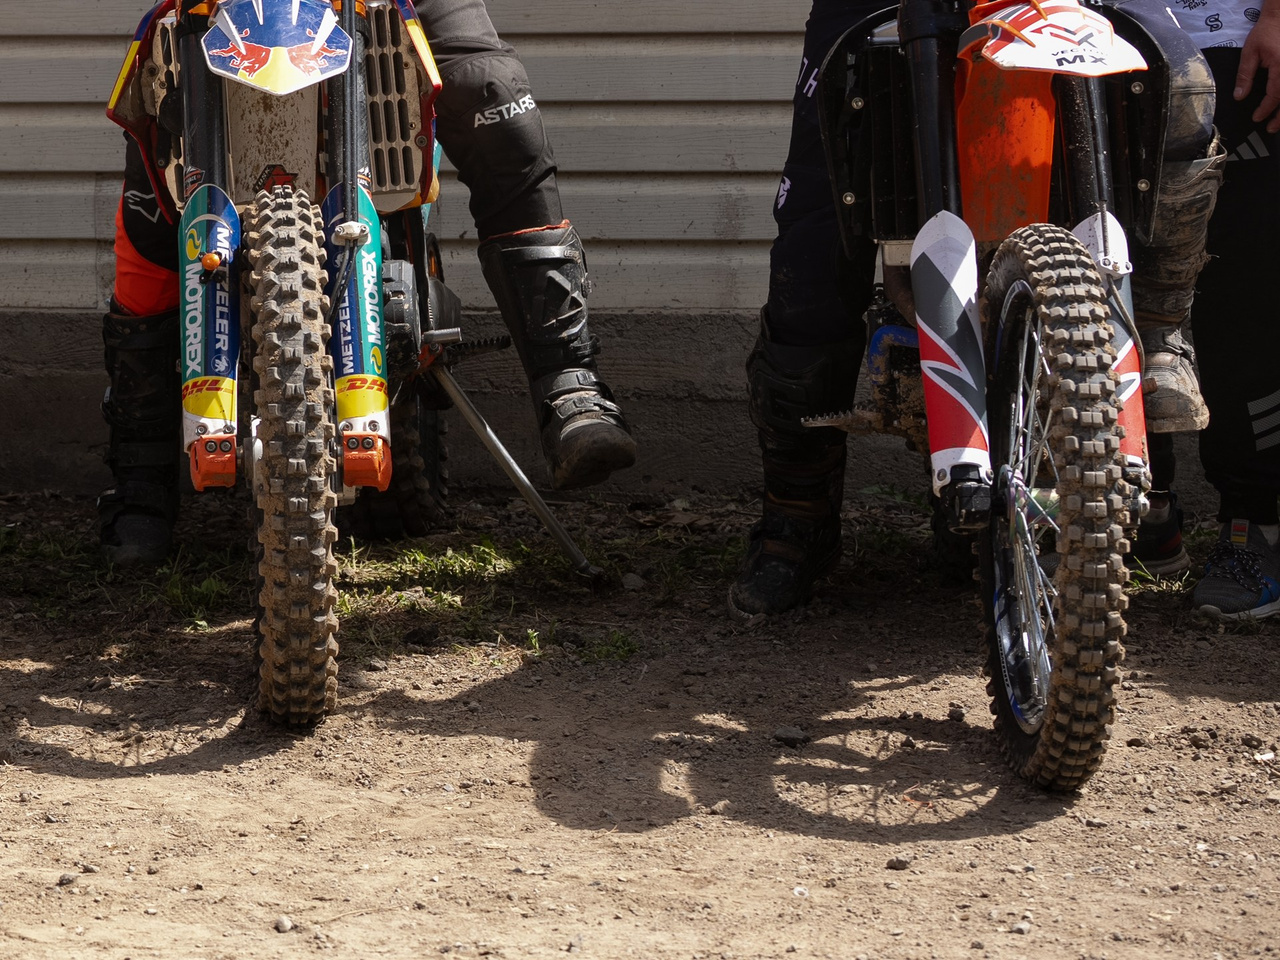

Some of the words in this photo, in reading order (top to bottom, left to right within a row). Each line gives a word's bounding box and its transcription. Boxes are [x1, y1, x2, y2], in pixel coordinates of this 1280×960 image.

[1056, 54, 1108, 67] MX
[474, 93, 536, 128] ASTARS
[185, 264, 202, 379] MOTOREX
[361, 249, 382, 345] MOTOREX
